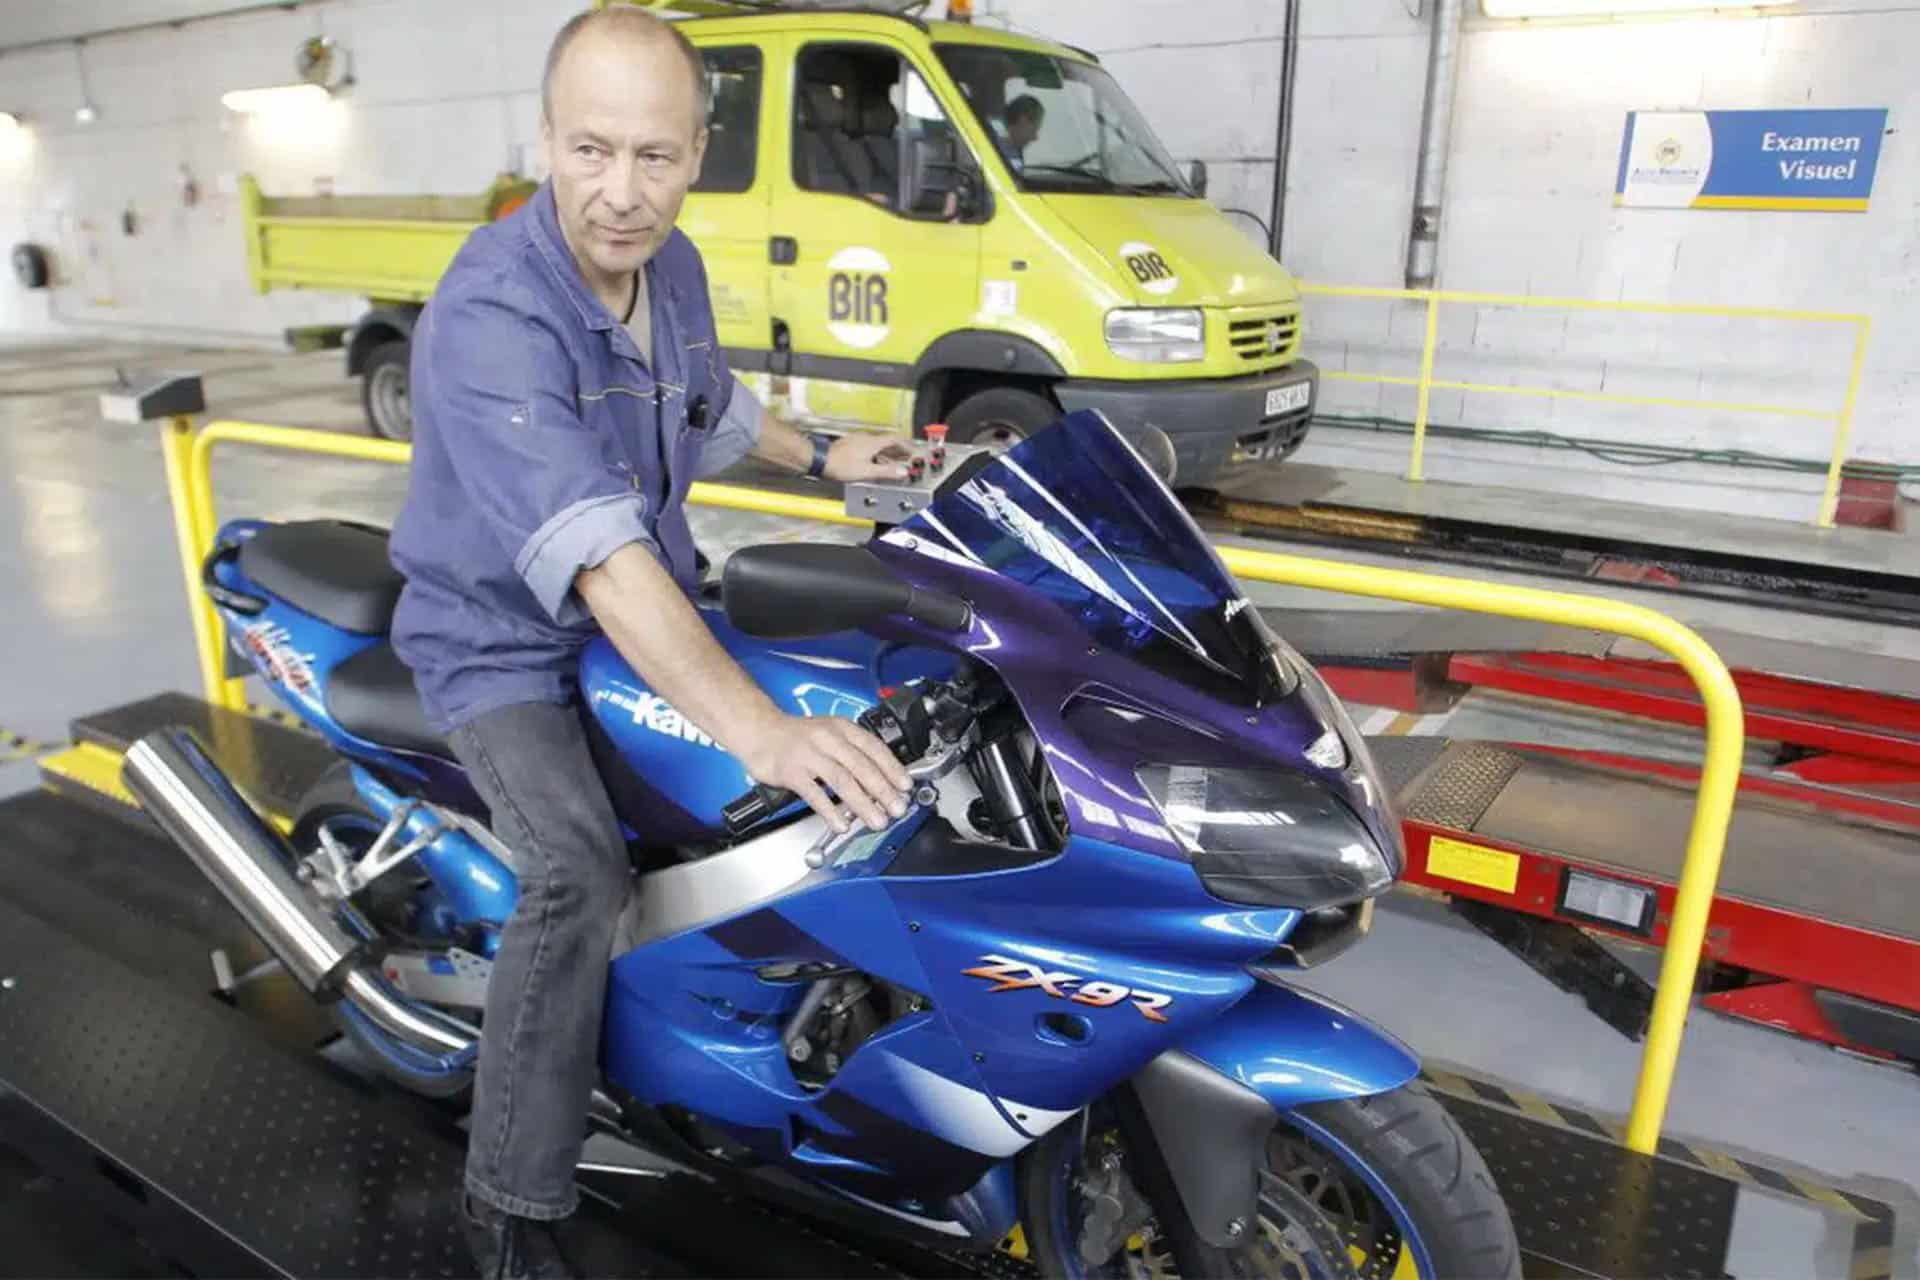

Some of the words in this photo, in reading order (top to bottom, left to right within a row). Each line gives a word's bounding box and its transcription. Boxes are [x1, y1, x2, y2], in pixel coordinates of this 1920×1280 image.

[1761, 132, 1861, 152] Examen
[1779, 159, 1857, 180] Visuel
[829, 272, 888, 324] BiR
[960, 953, 1173, 1023] ZX-9R
